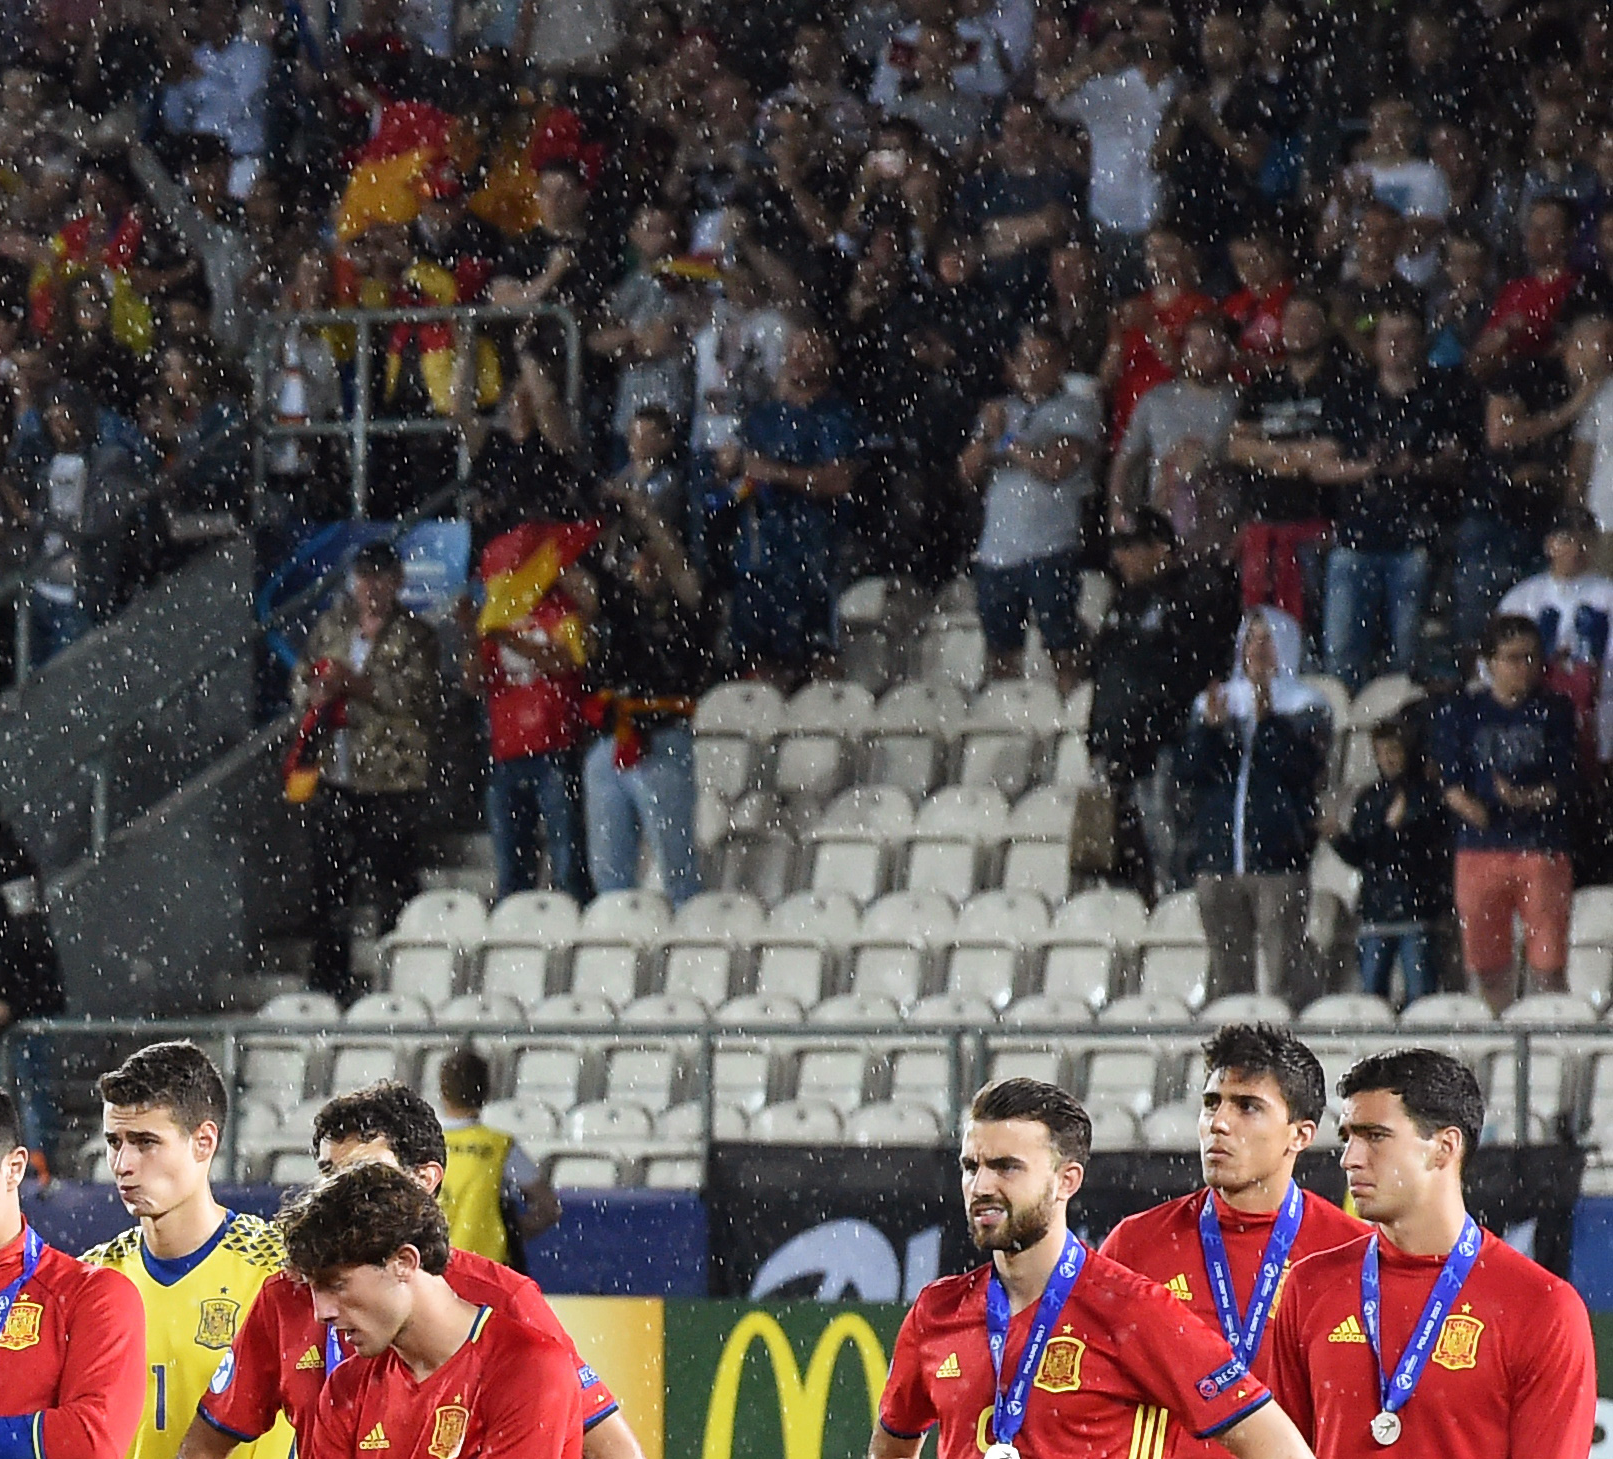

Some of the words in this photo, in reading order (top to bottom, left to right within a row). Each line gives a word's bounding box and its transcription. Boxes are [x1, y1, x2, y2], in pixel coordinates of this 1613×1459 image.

[1022, 1343, 1039, 1374] POLAND
[1034, 1323, 1047, 1343] 2017
[1327, 1332, 1368, 1343] adidas
[1417, 1324, 1434, 1350] POLAND
[1429, 1301, 1444, 1324] 2017
[152, 1365, 165, 1431] 1
